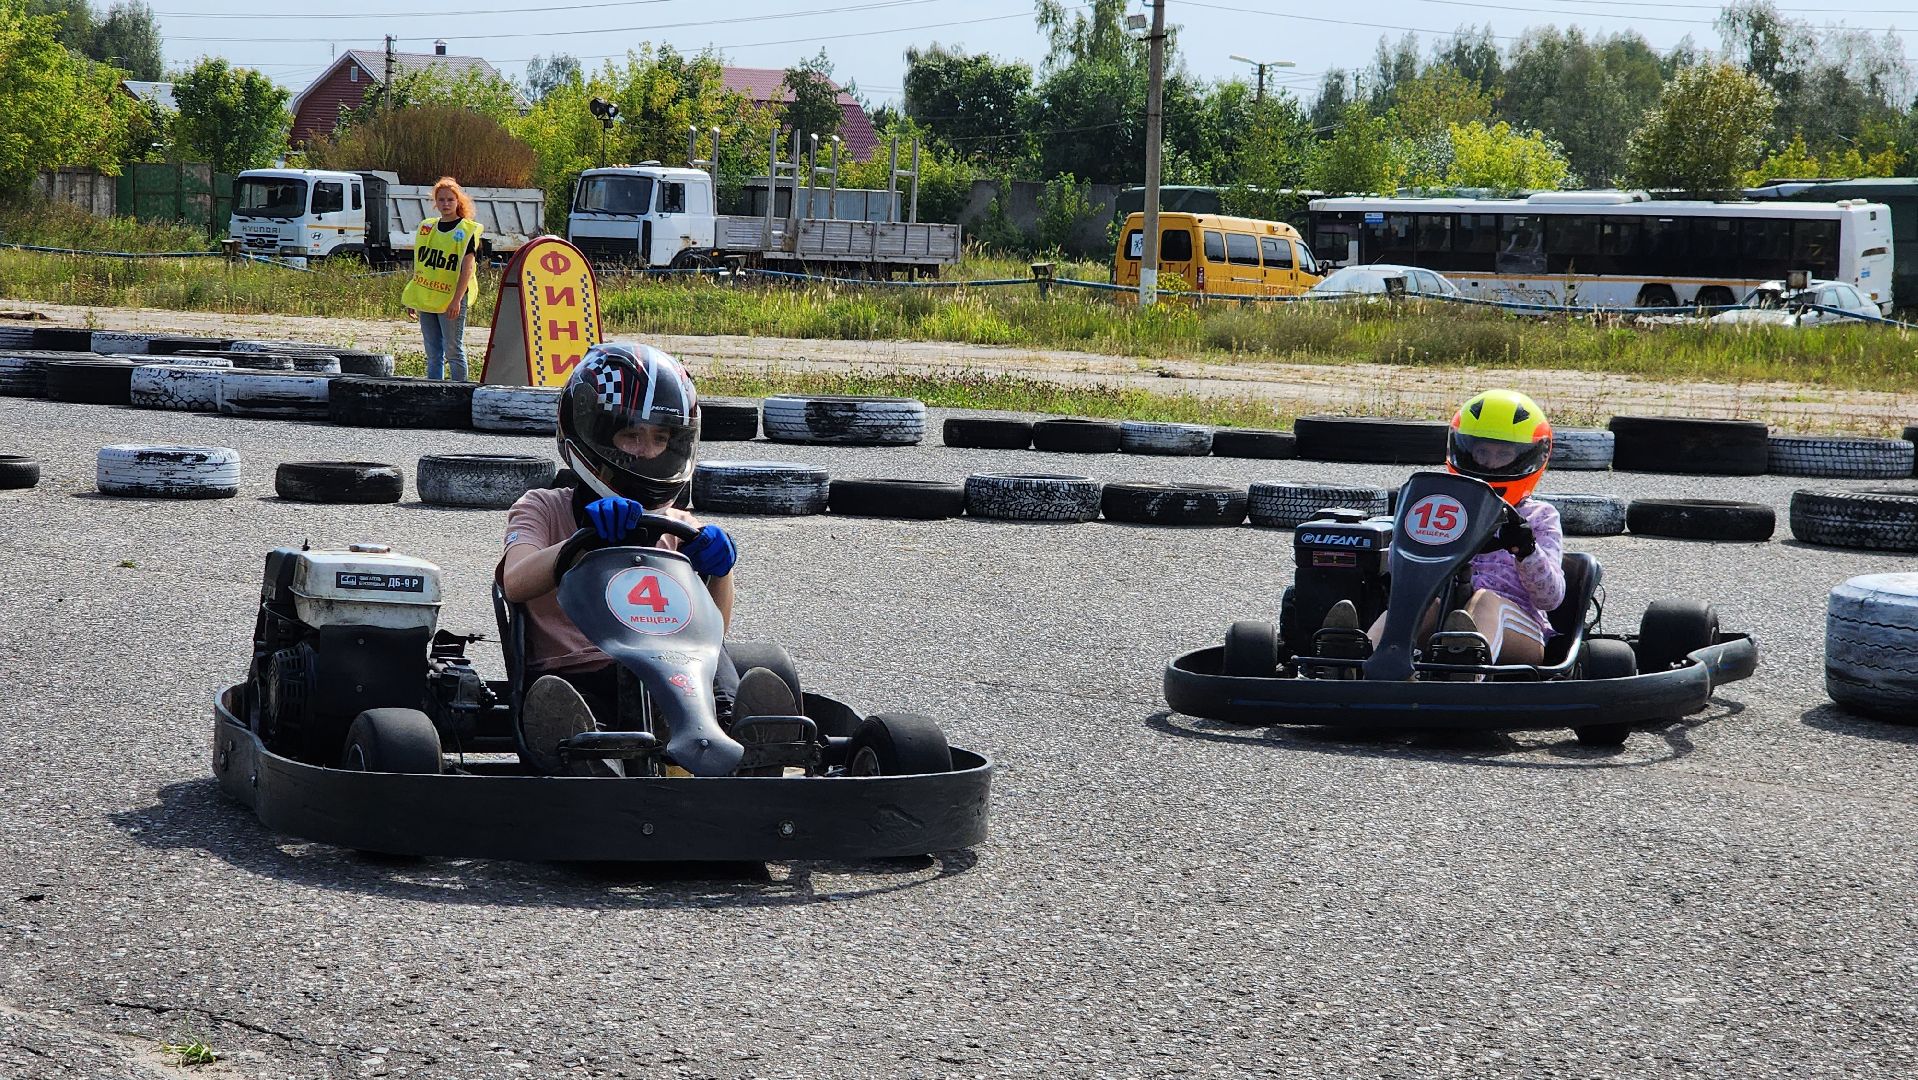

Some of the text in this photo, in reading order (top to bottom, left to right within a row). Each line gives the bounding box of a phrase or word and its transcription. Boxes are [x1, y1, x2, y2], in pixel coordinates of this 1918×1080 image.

[242, 225, 281, 234] HYUNDAI
[1127, 261, 1191, 280] ДТИ
[1414, 502, 1459, 531] 15
[1314, 534, 1359, 545] LIFAN
[627, 575, 669, 612] 4
